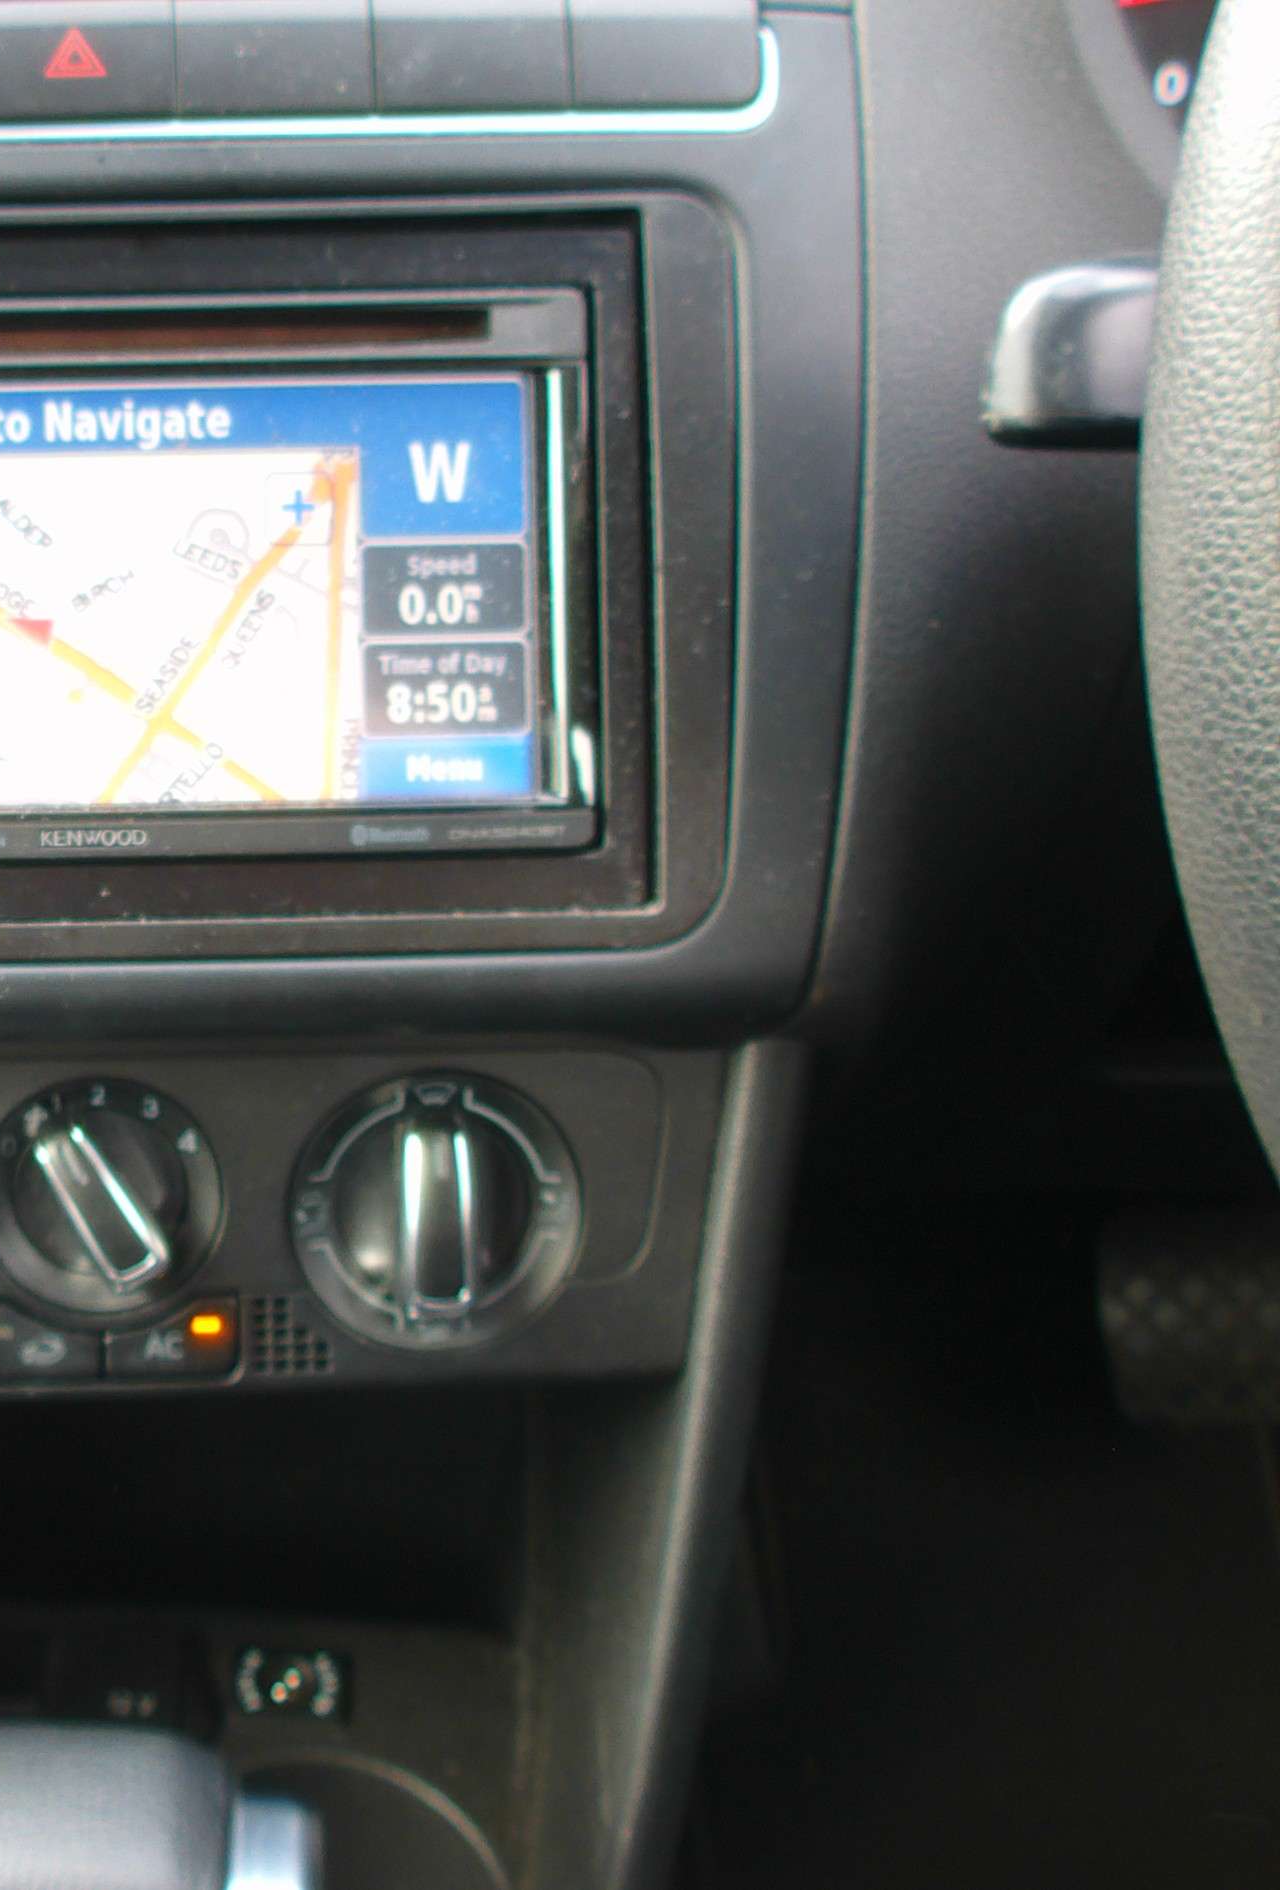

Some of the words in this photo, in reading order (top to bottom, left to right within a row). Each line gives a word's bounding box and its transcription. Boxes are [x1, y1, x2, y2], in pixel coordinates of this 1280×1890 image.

[1153, 61, 1190, 107] 0
[43, 400, 232, 452] Navigate
[408, 440, 472, 504] W
[407, 551, 478, 580] Speed
[398, 583, 464, 625] 0.0
[135, 634, 202, 714] SEASIDE
[378, 654, 432, 676] Time
[437, 651, 461, 675] of
[465, 653, 509, 678] Day
[386, 682, 477, 725] 8:50
[406, 752, 486, 783] Menu
[40, 829, 148, 848] KENWOOD
[90, 1085, 107, 1107] 2
[142, 1096, 160, 1120] 3
[177, 1127, 199, 1153] 4
[144, 1329, 184, 1361] AC
